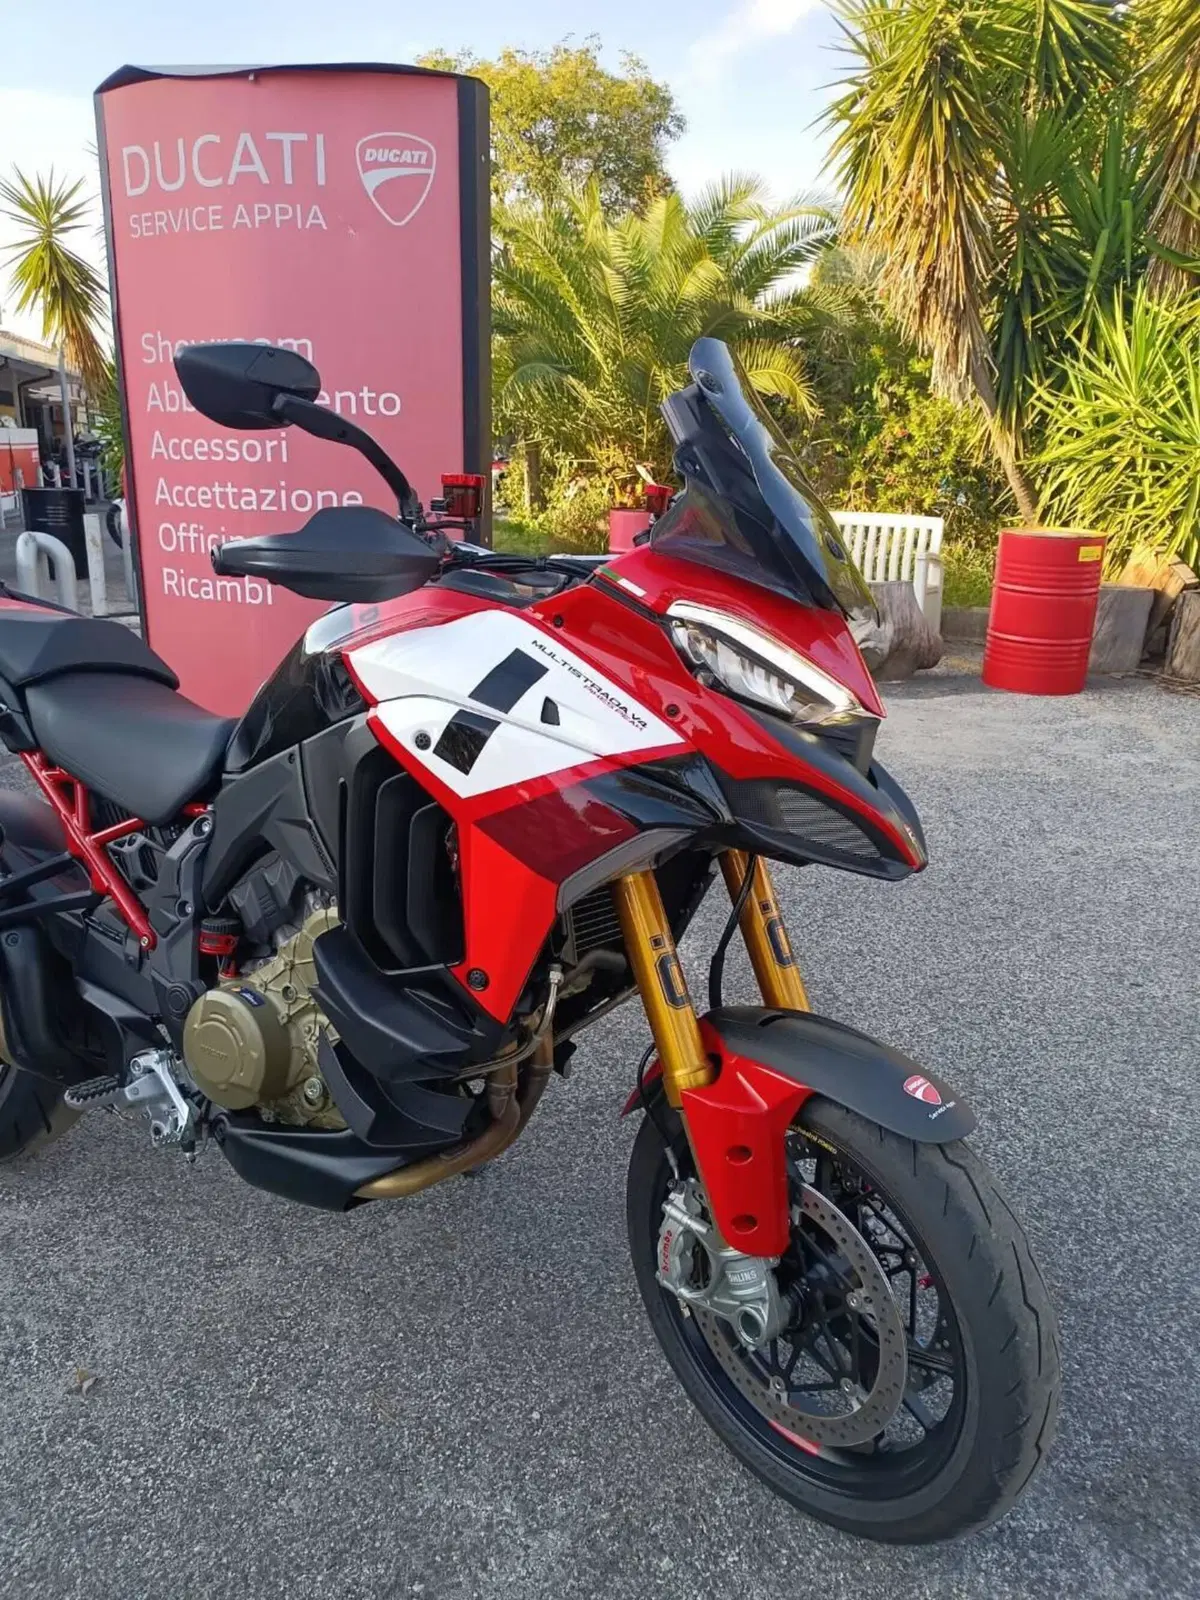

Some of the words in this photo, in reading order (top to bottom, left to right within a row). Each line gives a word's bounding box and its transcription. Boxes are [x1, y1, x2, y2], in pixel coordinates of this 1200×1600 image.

[122, 132, 326, 197] DUCATI
[365, 147, 428, 165] DUCATI
[129, 205, 224, 238] SERVICE
[232, 204, 327, 230] APPIA
[150, 431, 289, 463] Accessori
[155, 477, 363, 512] Accettazione
[162, 567, 273, 605] Ricambi
[531, 639, 628, 714] MULTISTRADA
[631, 712, 648, 728] V4
[662, 1229, 673, 1272] brembo
